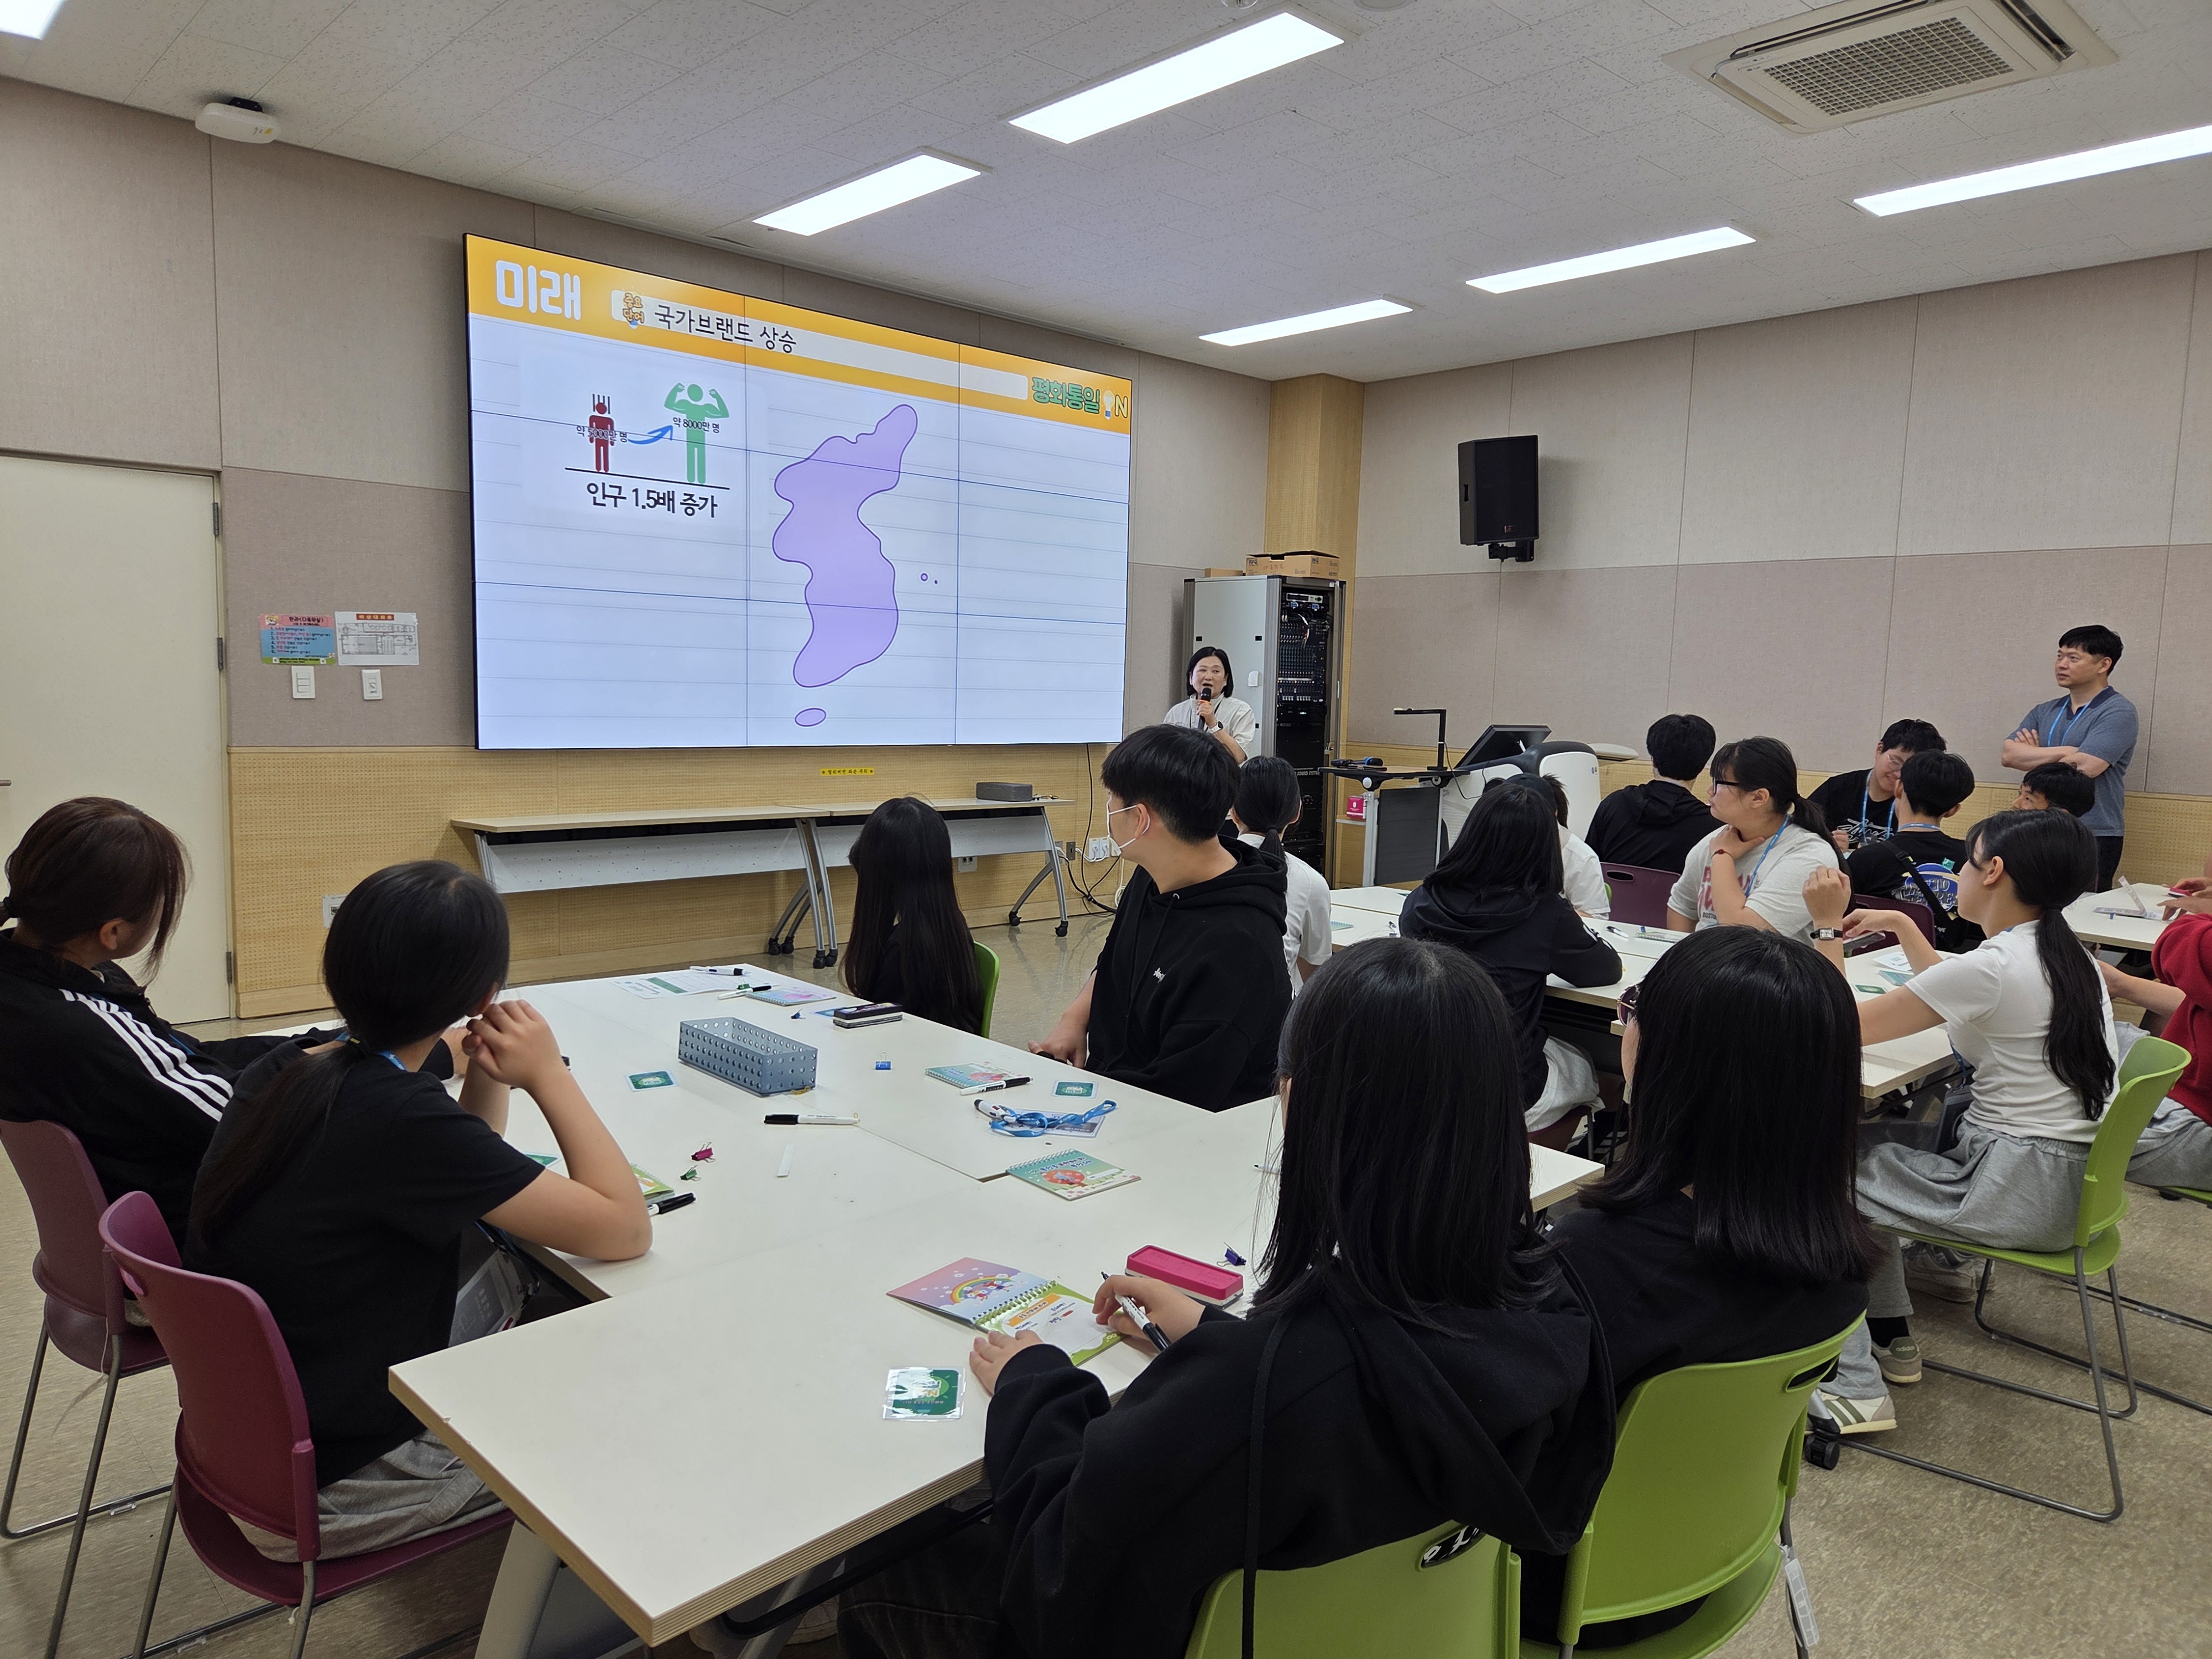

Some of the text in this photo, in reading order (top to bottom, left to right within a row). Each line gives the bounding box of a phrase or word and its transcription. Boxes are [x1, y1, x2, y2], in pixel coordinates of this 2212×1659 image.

[496, 260, 581, 320] 미래
[623, 293, 644, 309] 중요
[622, 308, 645, 324] 단어
[655, 305, 796, 354] 국가브랜드 상승
[1032, 377, 1100, 414] 평화통일
[576, 425, 585, 437] 약
[619, 432, 627, 442] 명
[673, 417, 719, 434] 약 8000만 명
[587, 482, 718, 518] 인구 1.5배 증가
[1703, 911, 1717, 920] BOSTO
